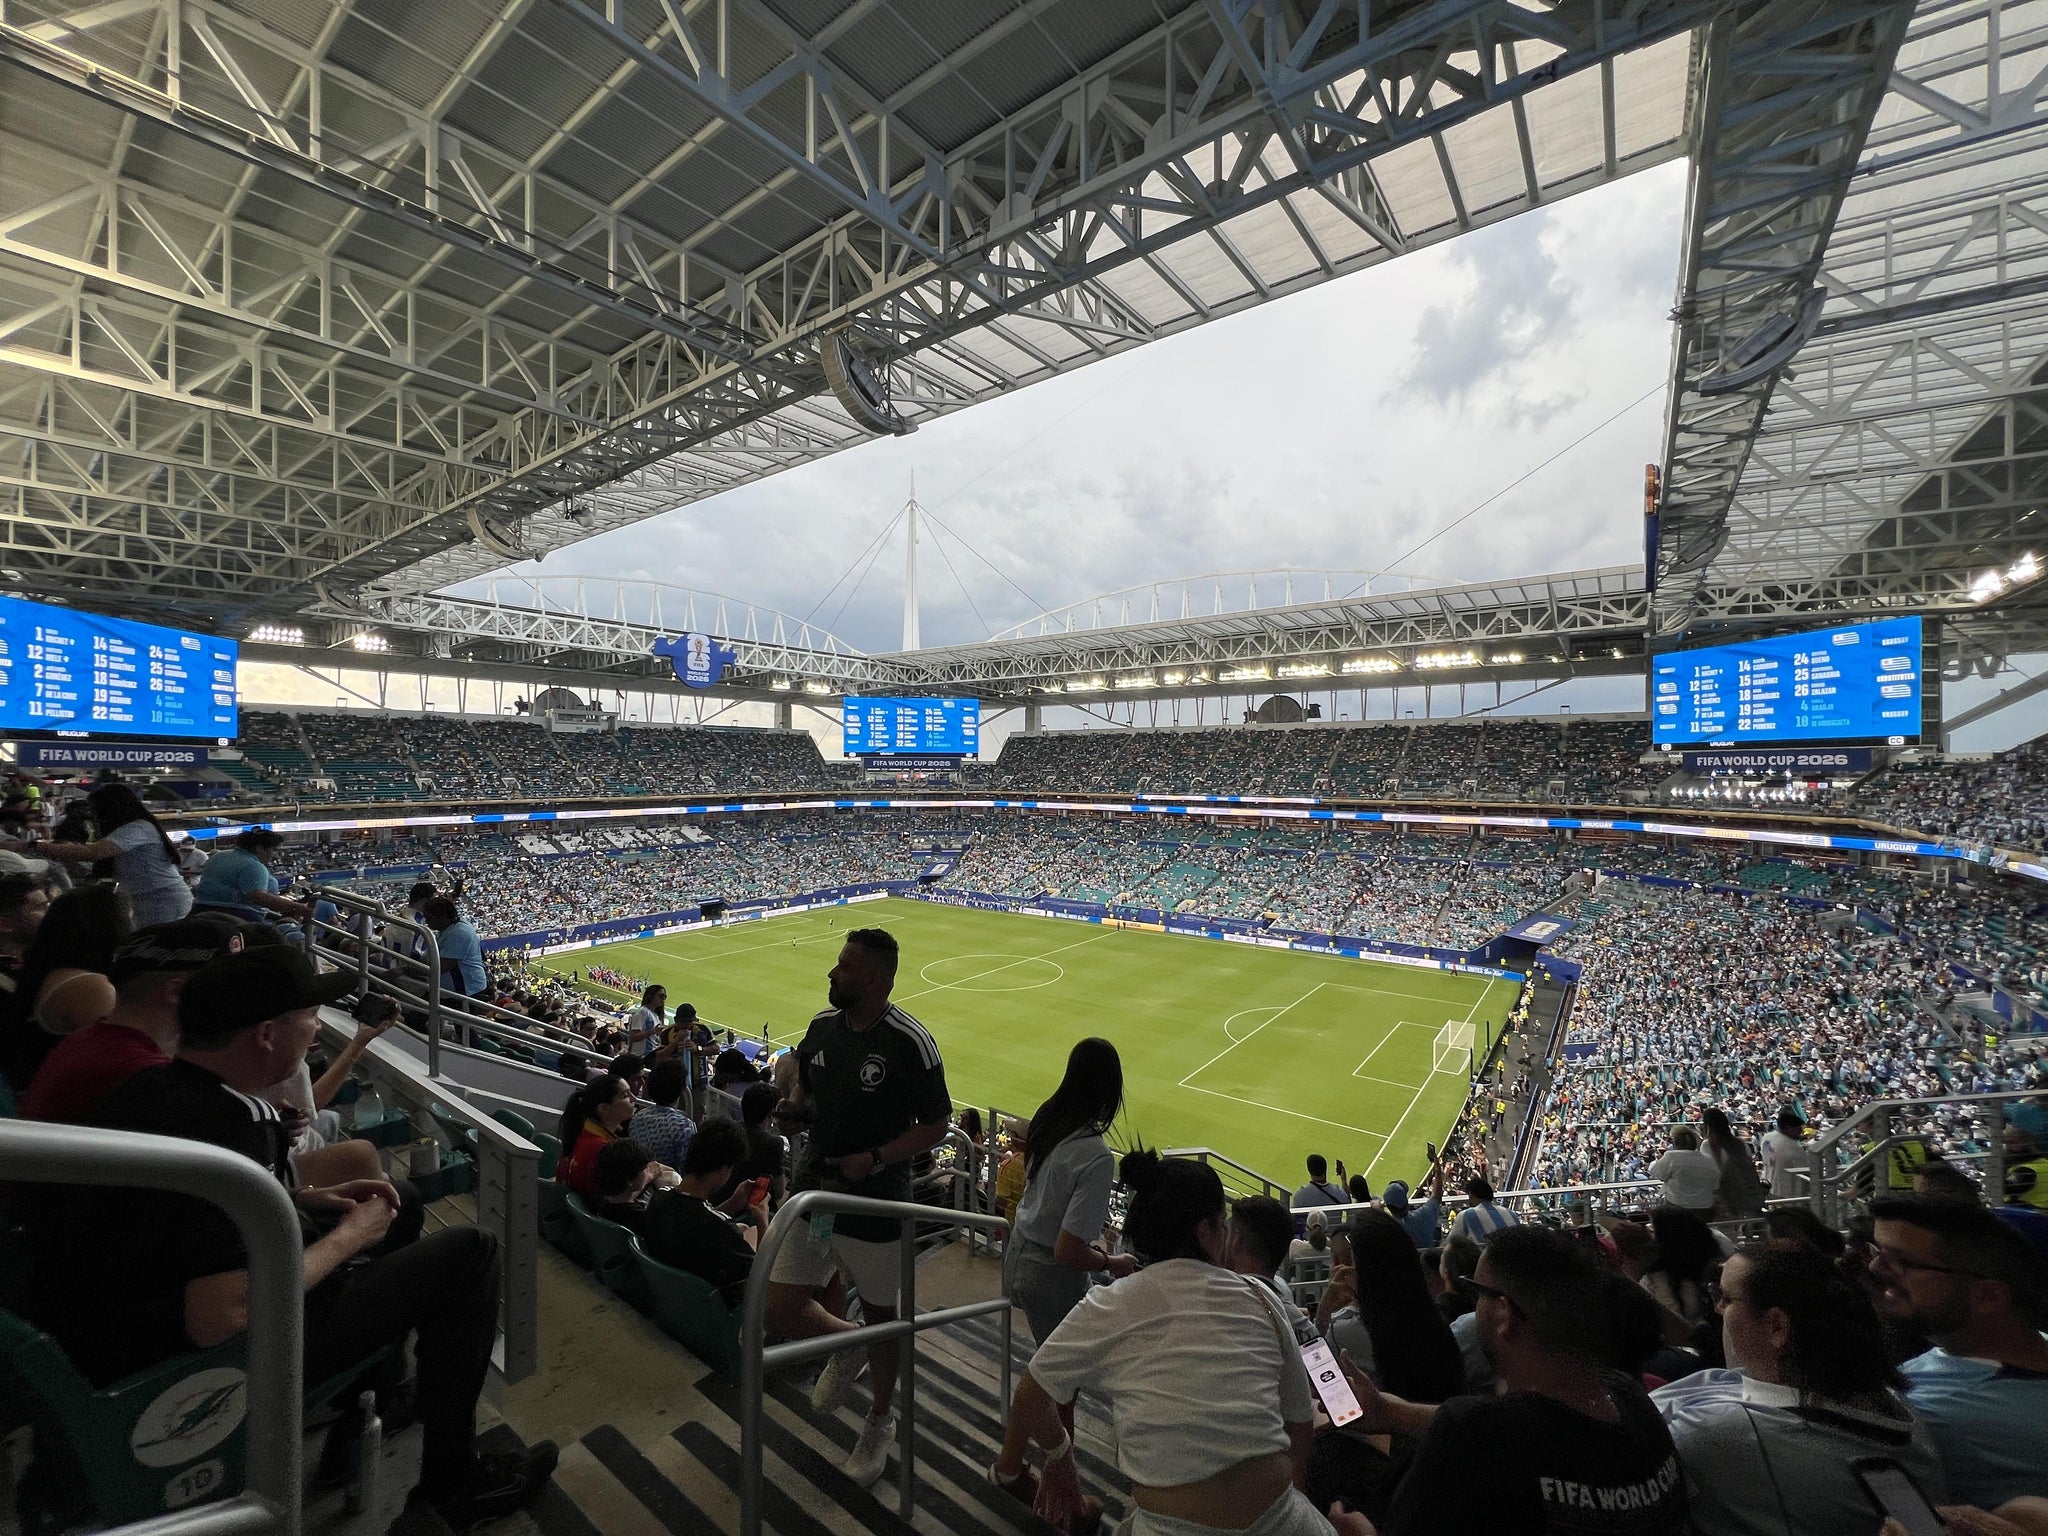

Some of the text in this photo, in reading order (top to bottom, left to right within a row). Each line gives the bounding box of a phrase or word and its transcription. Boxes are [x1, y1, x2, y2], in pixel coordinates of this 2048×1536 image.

[36, 626, 43, 641] 1
[94, 636, 107, 650] 14
[28, 644, 43, 660] 12
[150, 645, 162, 658] 24
[94, 654, 107, 668] 15
[1794, 653, 1809, 666] 24
[34, 664, 43, 678] 2
[150, 662, 162, 675] 25
[1694, 666, 1700, 677] 1
[1738, 660, 1750, 672] 14
[94, 671, 107, 685] 18
[1739, 675, 1750, 686] 15
[1794, 668, 1808, 681] 25
[35, 683, 43, 697] 7
[150, 678, 162, 690] 26
[1690, 680, 1700, 692] 12
[1794, 684, 1808, 696] 26
[94, 688, 107, 702] 19
[156, 695, 162, 706] 4
[1694, 694, 1700, 704] 2
[1738, 690, 1750, 702] 18
[29, 701, 42, 716] 11
[1739, 704, 1750, 716] 19
[1801, 700, 1808, 711] 4
[93, 706, 107, 720] 22
[1694, 708, 1700, 718] 7
[1690, 722, 1700, 732] 11
[1738, 719, 1750, 730] 22
[40, 749, 194, 762] FIFA WORLD CUP 2026
[1697, 755, 1848, 766] FIFA WORLD CUP 2026
[1875, 842, 1917, 852] URUGUAY
[1467, 966, 1482, 974] UNITES
[1540, 1477, 1596, 1509] FIFA
[1596, 1478, 1660, 1511] WORLD
